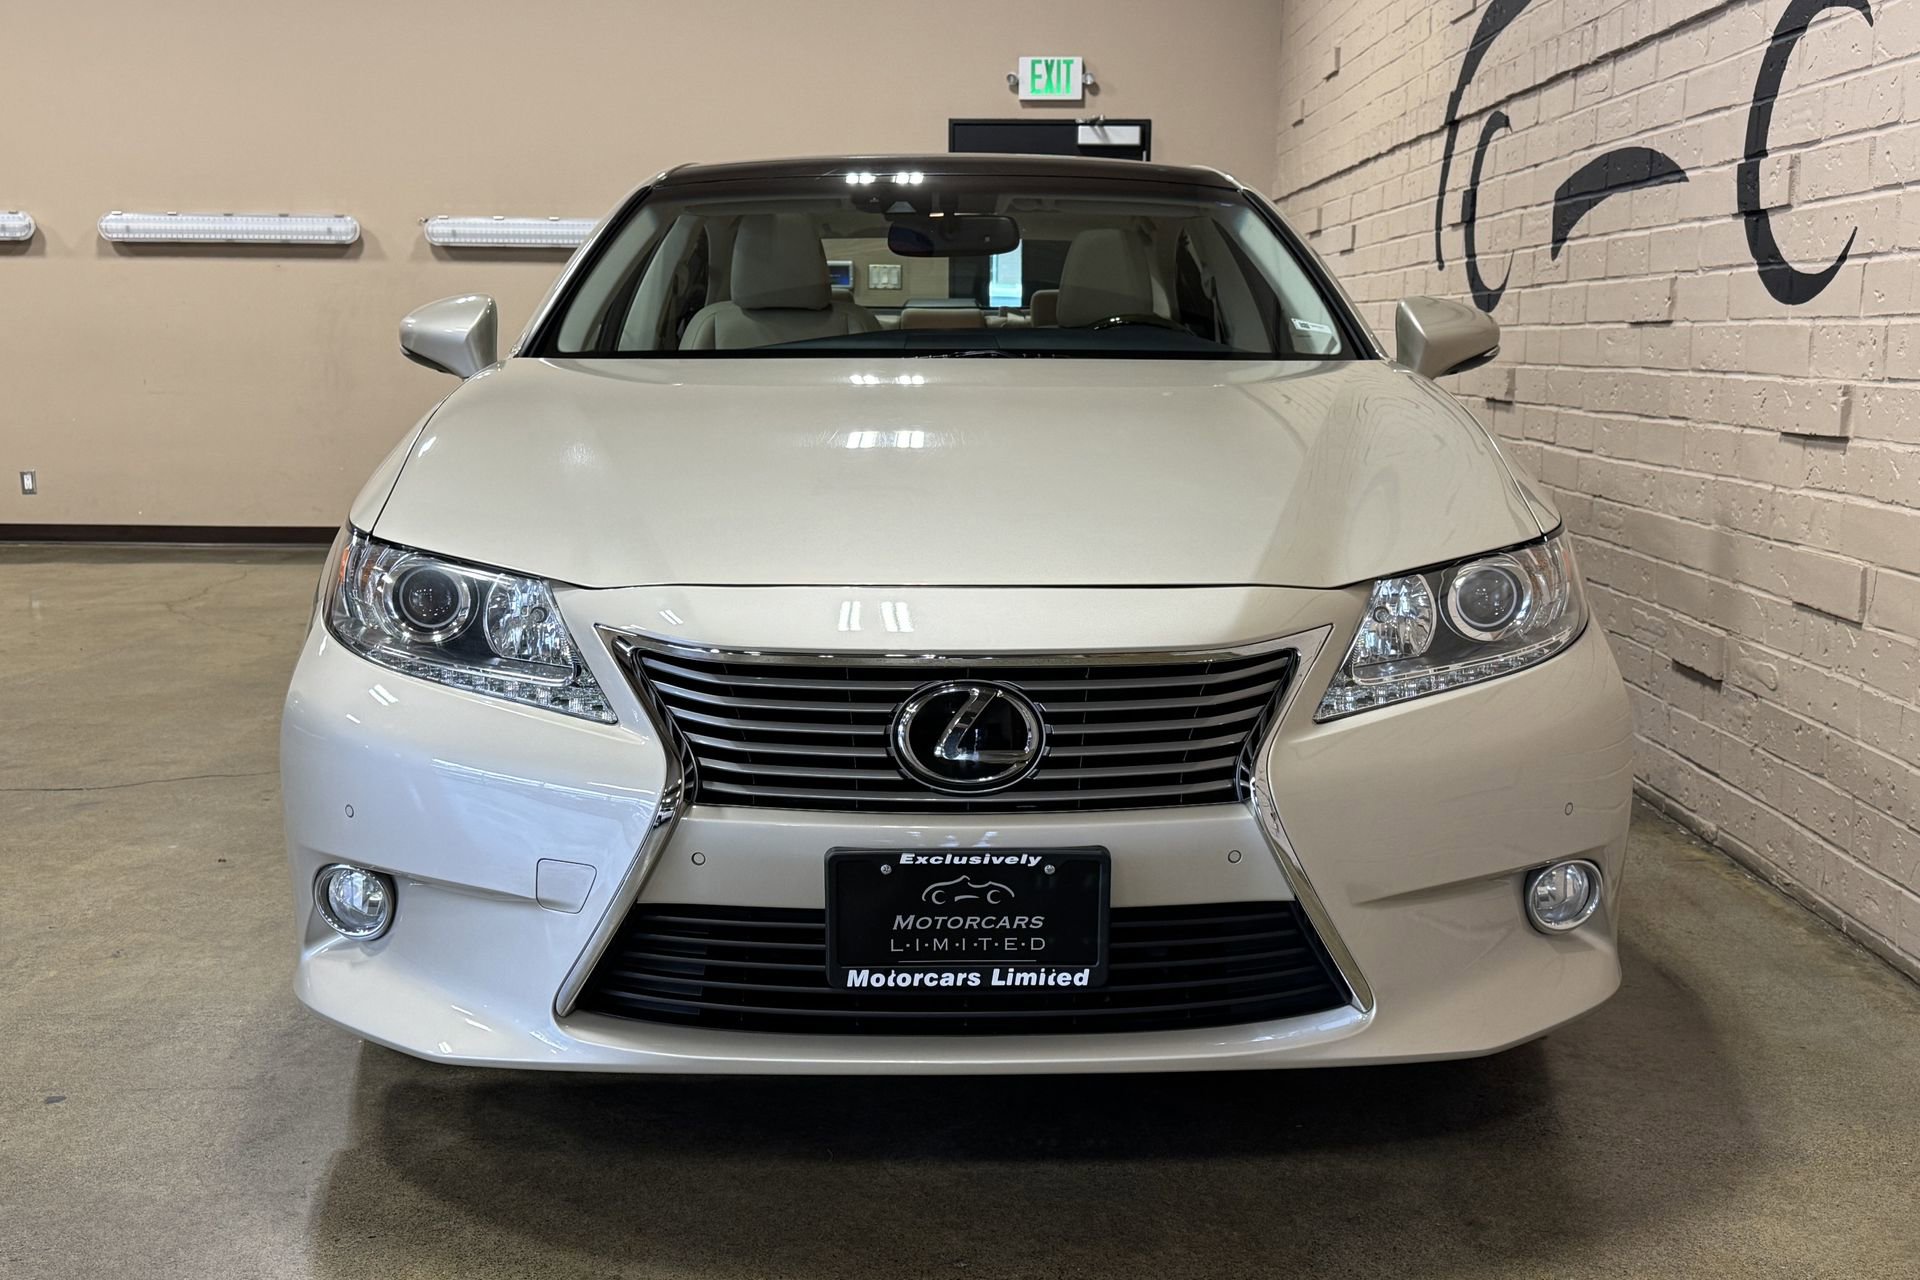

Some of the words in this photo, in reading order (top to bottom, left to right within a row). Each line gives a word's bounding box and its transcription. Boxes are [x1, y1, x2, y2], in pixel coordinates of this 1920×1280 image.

[1031, 59, 1074, 95] EXIT
[900, 853, 1042, 867] Exclusively
[892, 914, 1045, 930] MOTORCARS
[847, 969, 981, 987] Motorcars
[991, 968, 1090, 986] Limited
